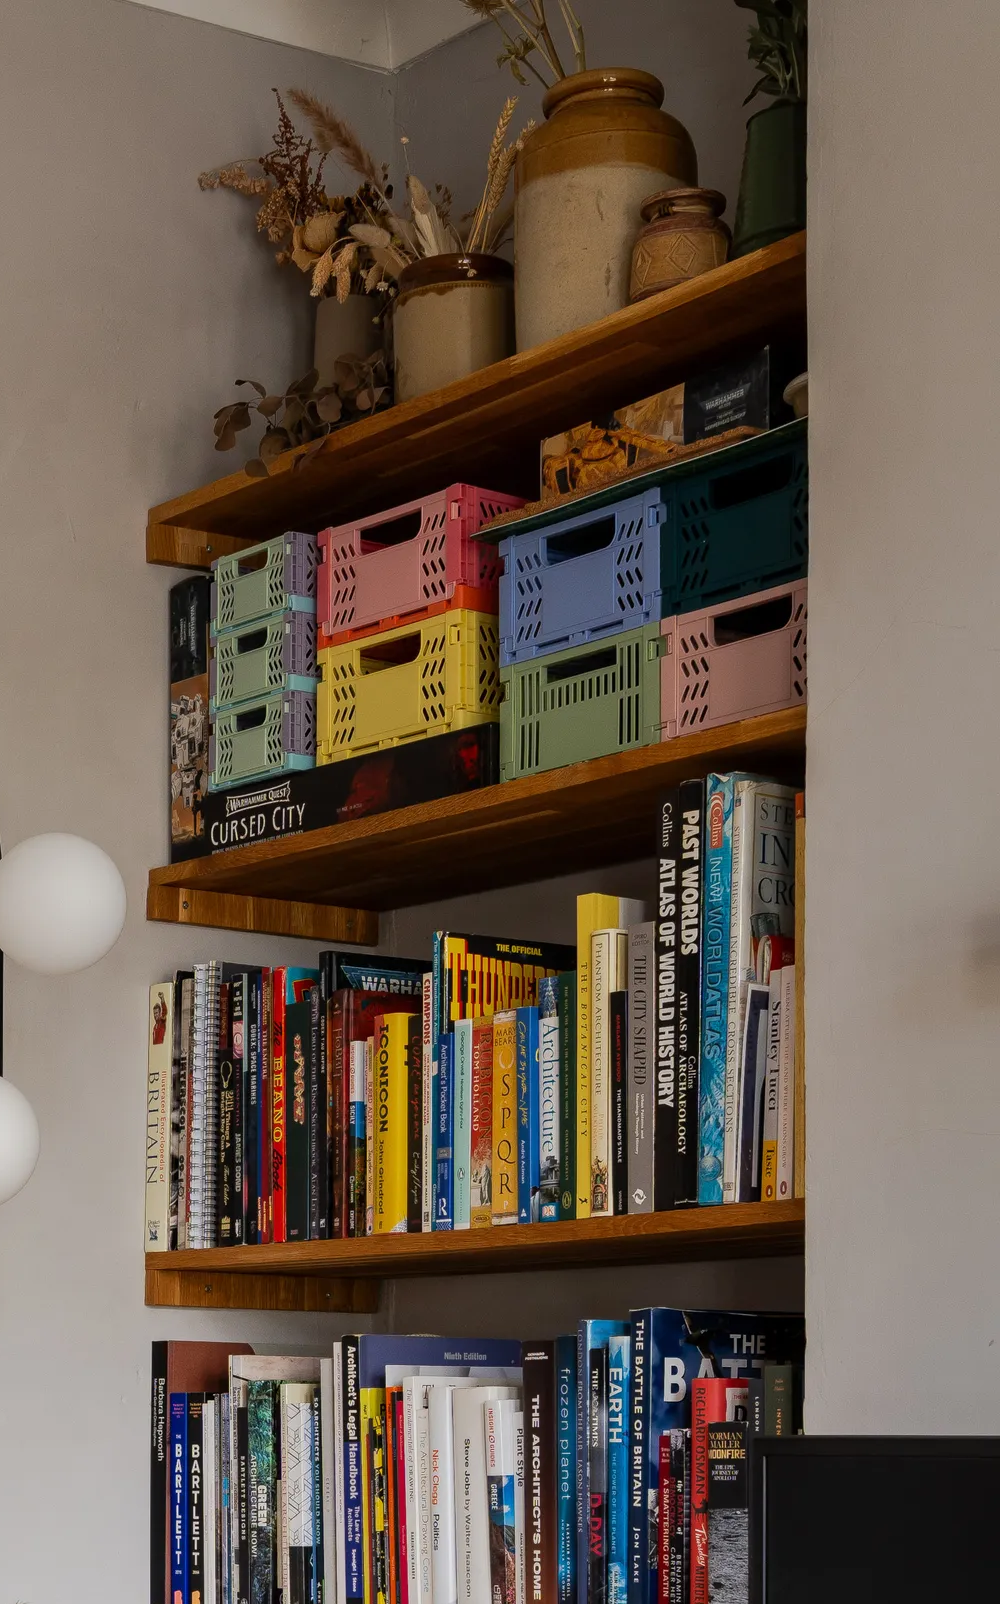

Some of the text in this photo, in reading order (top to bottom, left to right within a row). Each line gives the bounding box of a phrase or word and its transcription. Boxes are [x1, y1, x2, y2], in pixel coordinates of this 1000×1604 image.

[705, 388, 745, 411] WARHAMMER
[190, 604, 198, 652] WARHAMMER
[211, 814, 265, 847] CURSED
[272, 803, 306, 833] CITY
[229, 787, 288, 812] WARHAMMER QUEST
[681, 811, 699, 955] PAST WORLDS
[496, 944, 542, 956] THE OFFICIAL
[657, 803, 675, 1108] Collins ATLAS OF WORLD HISTORY
[423, 979, 431, 1045] CHAMPIONS
[495, 1027, 517, 1037] MARY
[594, 943, 603, 1095] PHANTOM ARCHITECTURE
[633, 955, 647, 1085] THE CITY SHAPED
[379, 1024, 389, 1132] ICONICON
[440, 1044, 448, 1085] Architect's
[677, 991, 687, 1155] ATLAS OF ARCHAEOLOGY
[687, 1055, 696, 1089] Collins
[767, 1001, 781, 1111] Stanley Tucci
[272, 1022, 283, 1191] The BEANO Book
[479, 1032, 492, 1140] RUBICON
[542, 1022, 559, 1152] Architecture
[147, 1072, 159, 1184] BRITAIN
[377, 1164, 385, 1214] Grindrod
[765, 1147, 775, 1177] Taste
[730, 1333, 766, 1354] THE
[313, 1397, 318, 1408] 50
[347, 1346, 358, 1499] Architect's Legal Handbook
[609, 1368, 623, 1443] EARTH
[633, 1319, 644, 1507] THE BATTLE OF BRITAIN
[156, 1417, 165, 1461] Hepworth
[516, 1428, 525, 1487] Plant Style
[559, 1368, 571, 1500] frozen planet
[709, 1432, 742, 1440] NORMAN
[174, 1443, 182, 1565] BARTLETT
[191, 1444, 200, 1566] BARTLETT
[257, 1485, 267, 1527] GREEN
[420, 1451, 429, 1505] Architectural
[430, 1476, 440, 1505] Clegg
[464, 1499, 472, 1511] by
[531, 1394, 542, 1600] THE ARCHITECT'S HOME
[420, 1507, 430, 1555] Drawing
[433, 1514, 441, 1551] Politics
[465, 1514, 473, 1547] Walter
[590, 1494, 602, 1556] D-DAY
